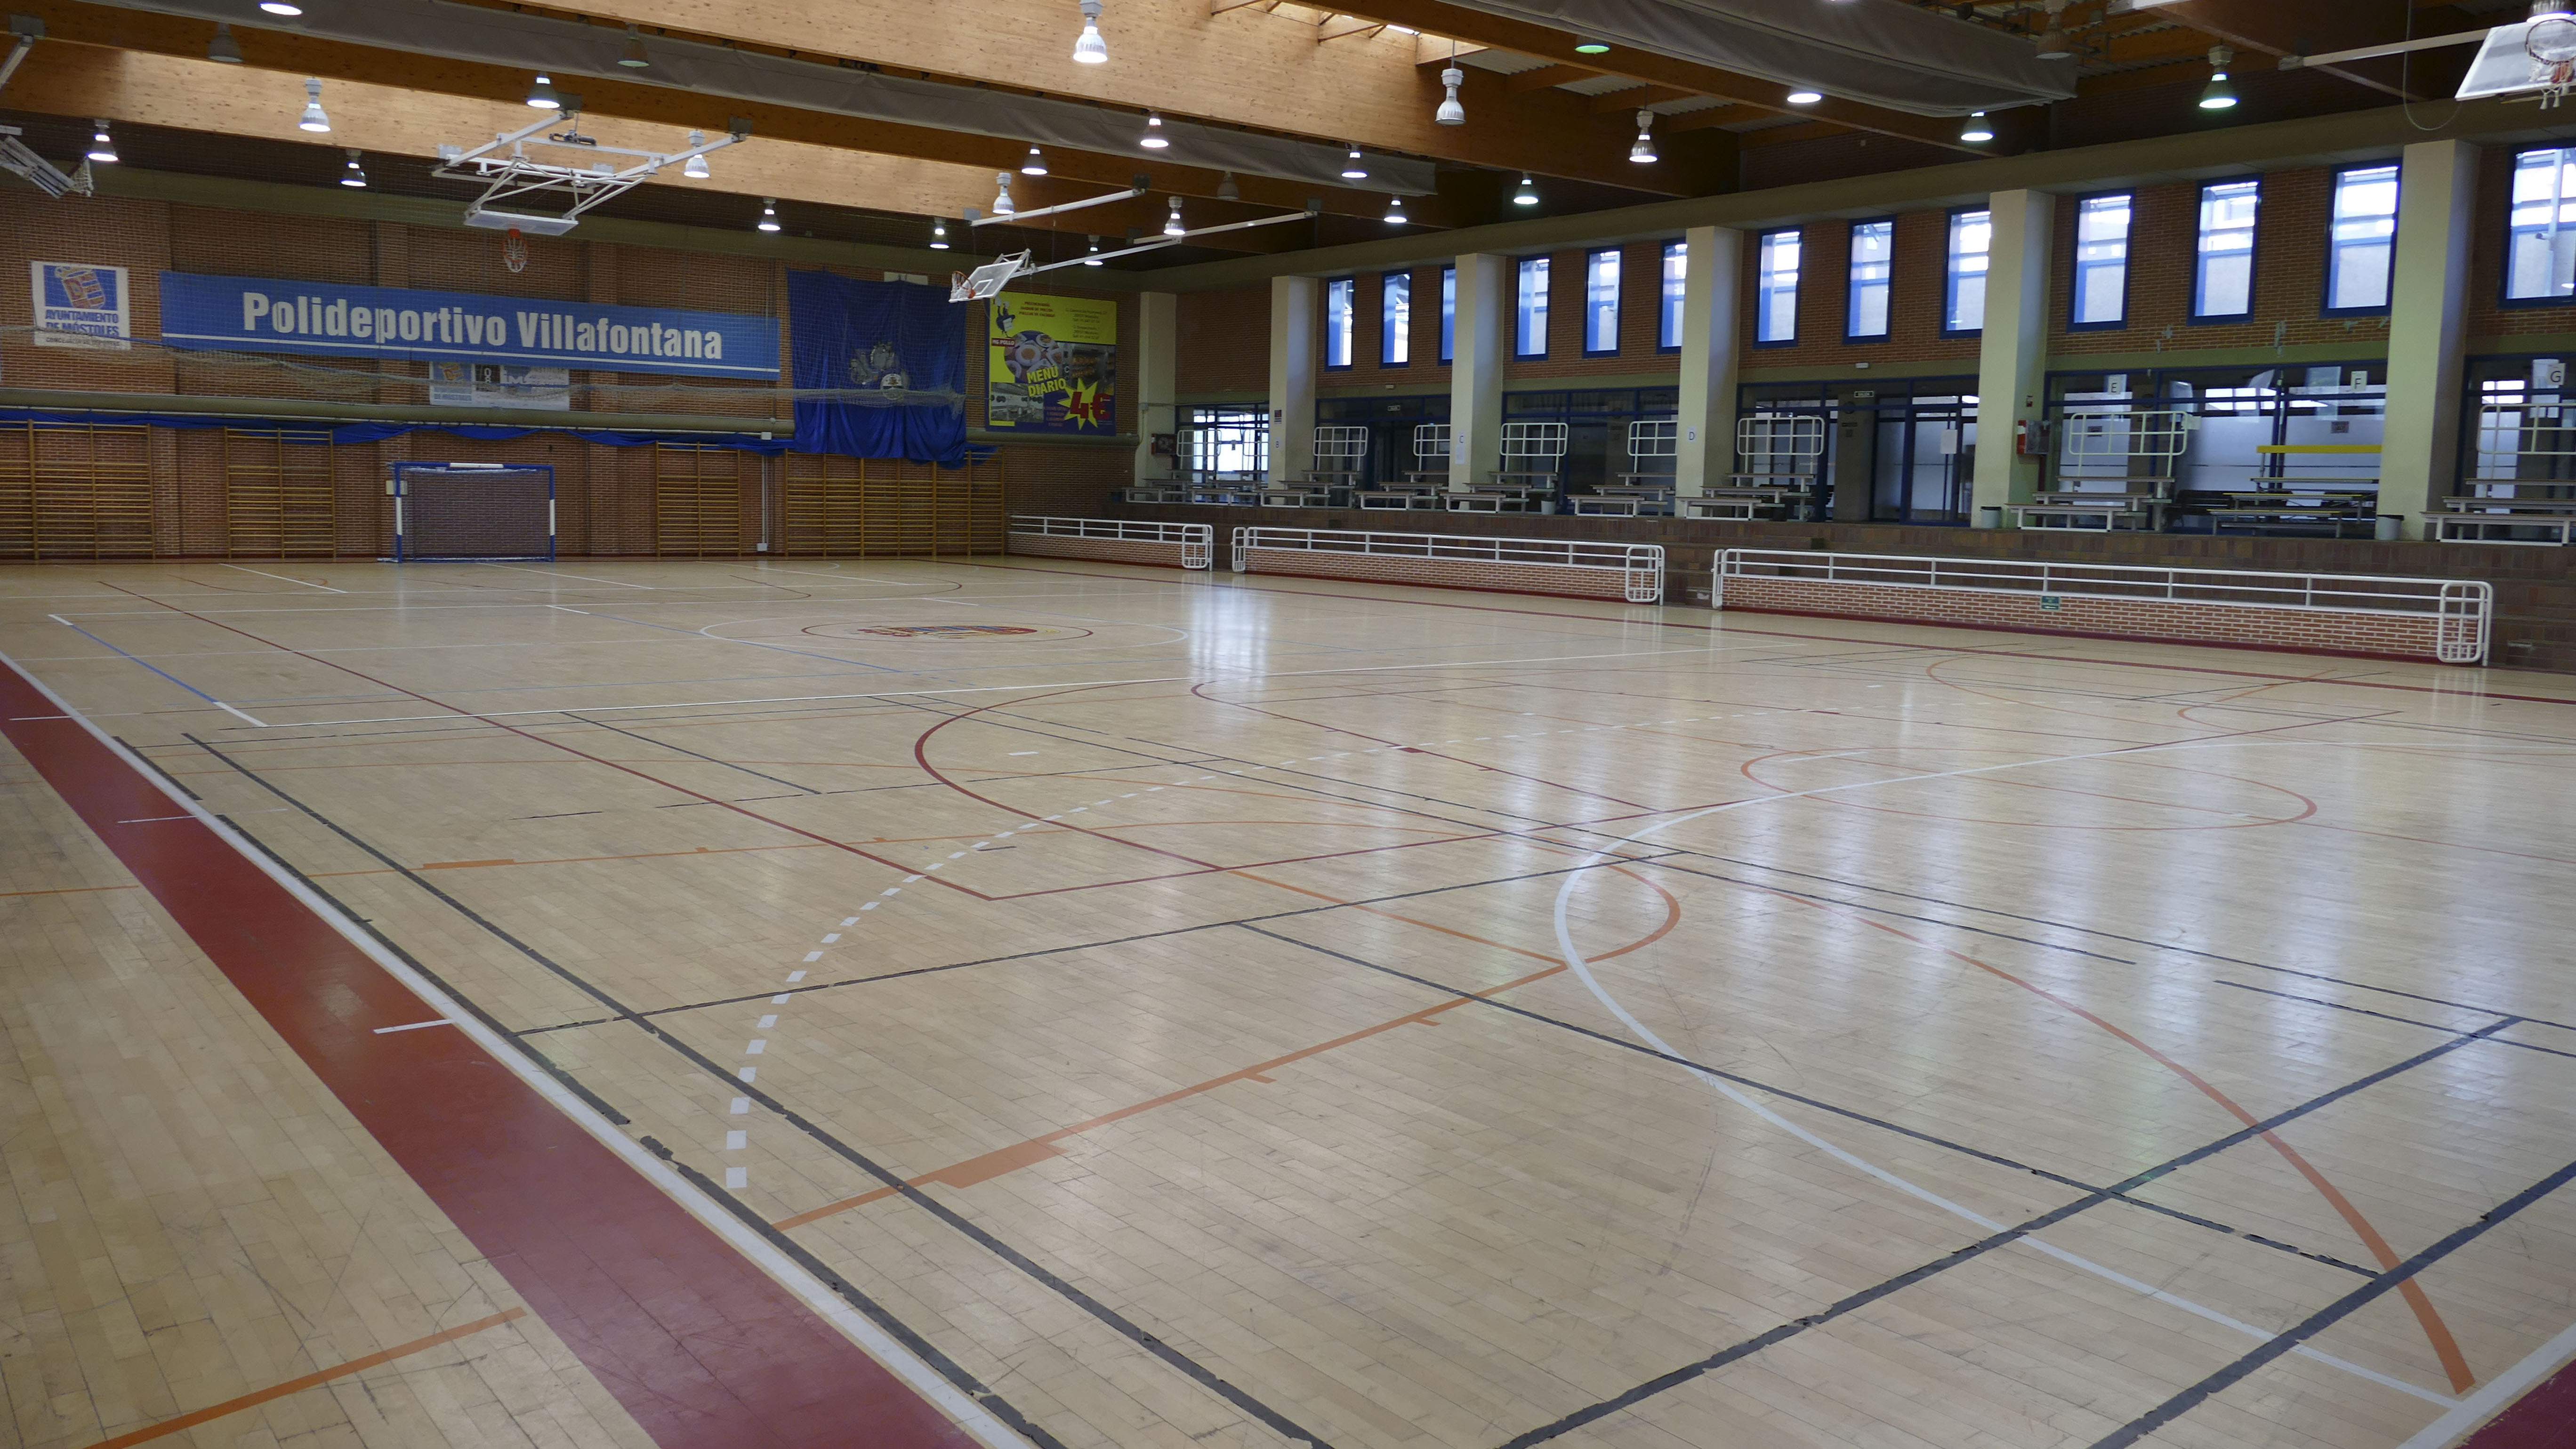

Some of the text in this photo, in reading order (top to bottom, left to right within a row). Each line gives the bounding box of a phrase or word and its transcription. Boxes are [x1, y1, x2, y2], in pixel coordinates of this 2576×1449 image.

[45, 309, 119, 323] AYUNTAMIENTO
[243, 292, 722, 359] Polideportivo Villafontana
[1026, 363, 1059, 383] MENÚ
[2550, 370, 2561, 383] G
[1028, 378, 1067, 397] DIARIO
[2111, 382, 2117, 393] E
[2355, 378, 2362, 389] F
[1070, 391, 1111, 419] 4€
[1459, 435, 1464, 443] C
[1689, 431, 1695, 441] D
